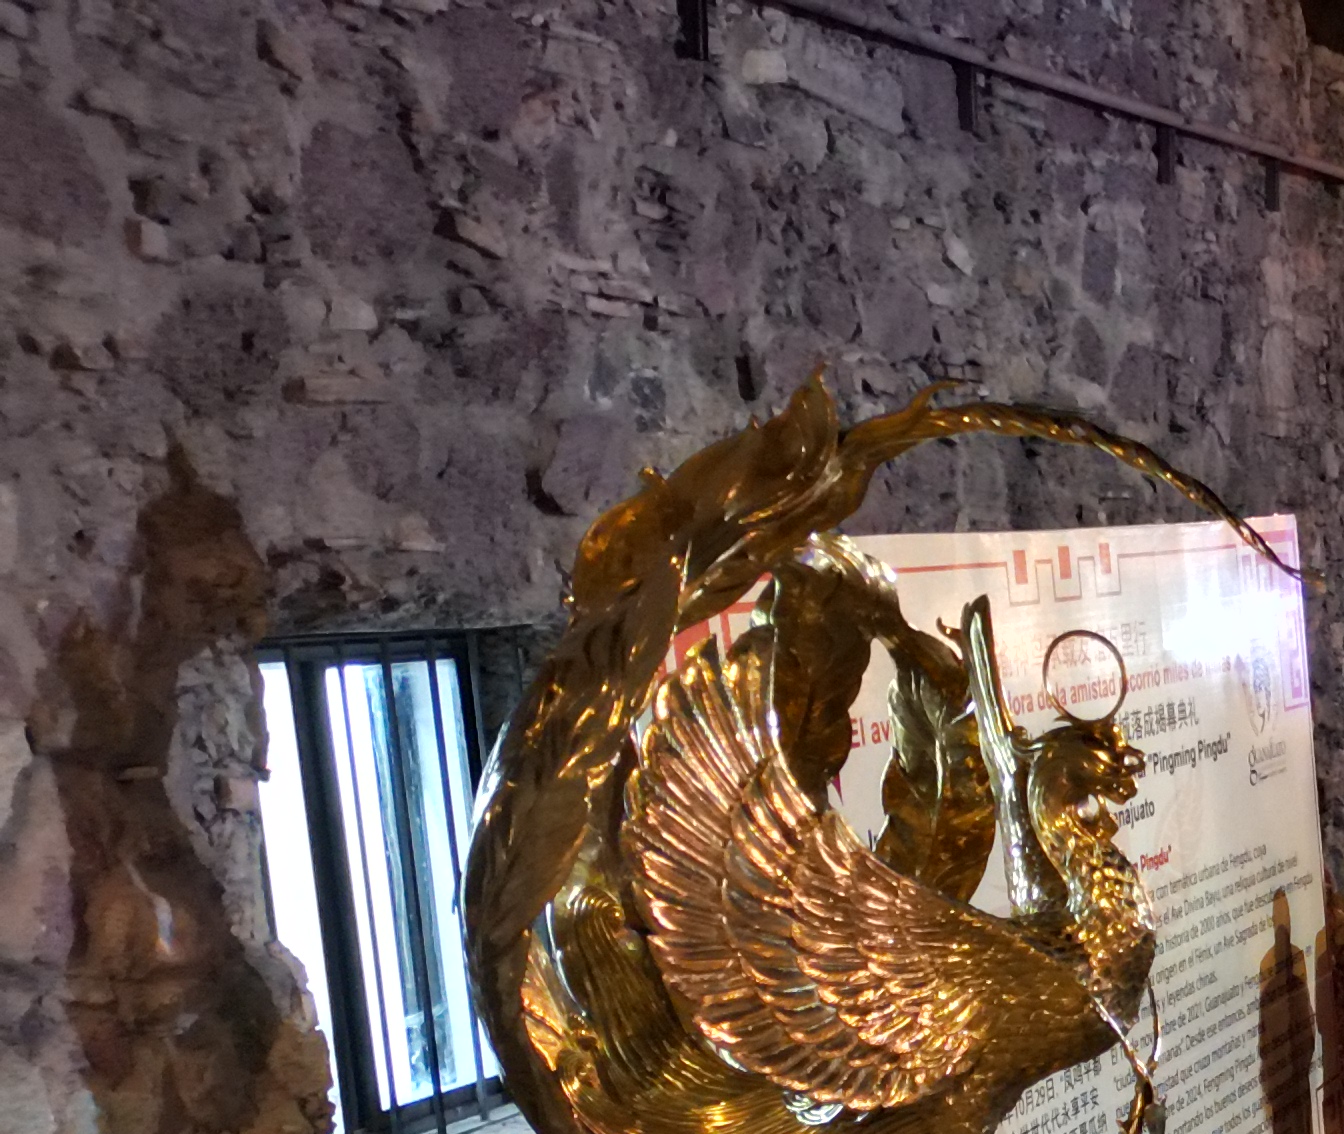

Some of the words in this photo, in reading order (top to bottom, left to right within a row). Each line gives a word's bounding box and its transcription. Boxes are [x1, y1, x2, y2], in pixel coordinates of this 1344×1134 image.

[851, 720, 865, 750] El
[1008, 692, 1034, 718] ora
[1069, 673, 1116, 702] amistad
[1118, 671, 1160, 694] corrió
[1147, 748, 1196, 773] "Pingming
[1197, 733, 1231, 760] Pingdu"
[1140, 845, 1172, 871] Pingdu"
[1155, 885, 1169, 899] con
[1197, 863, 1220, 881] urbana
[1220, 857, 1229, 872] de
[1164, 930, 1189, 949] historia
[1189, 925, 1198, 939] de
[1178, 959, 1187, 972] en
[1187, 951, 1194, 967] el
[1166, 981, 1195, 1005] leyendas
[1138, 1020, 1177, 1049] novmbre
[1176, 1012, 1186, 1027] de
[1185, 1029, 1205, 1050] Desde
[1179, 1065, 1193, 1082] que
[1175, 1096, 1185, 1111] de
[1204, 1105, 1213, 1119] los
[1213, 1090, 1236, 1112] buenos
[1223, 1113, 1241, 1132] todos
[1241, 1106, 1251, 1119] los
